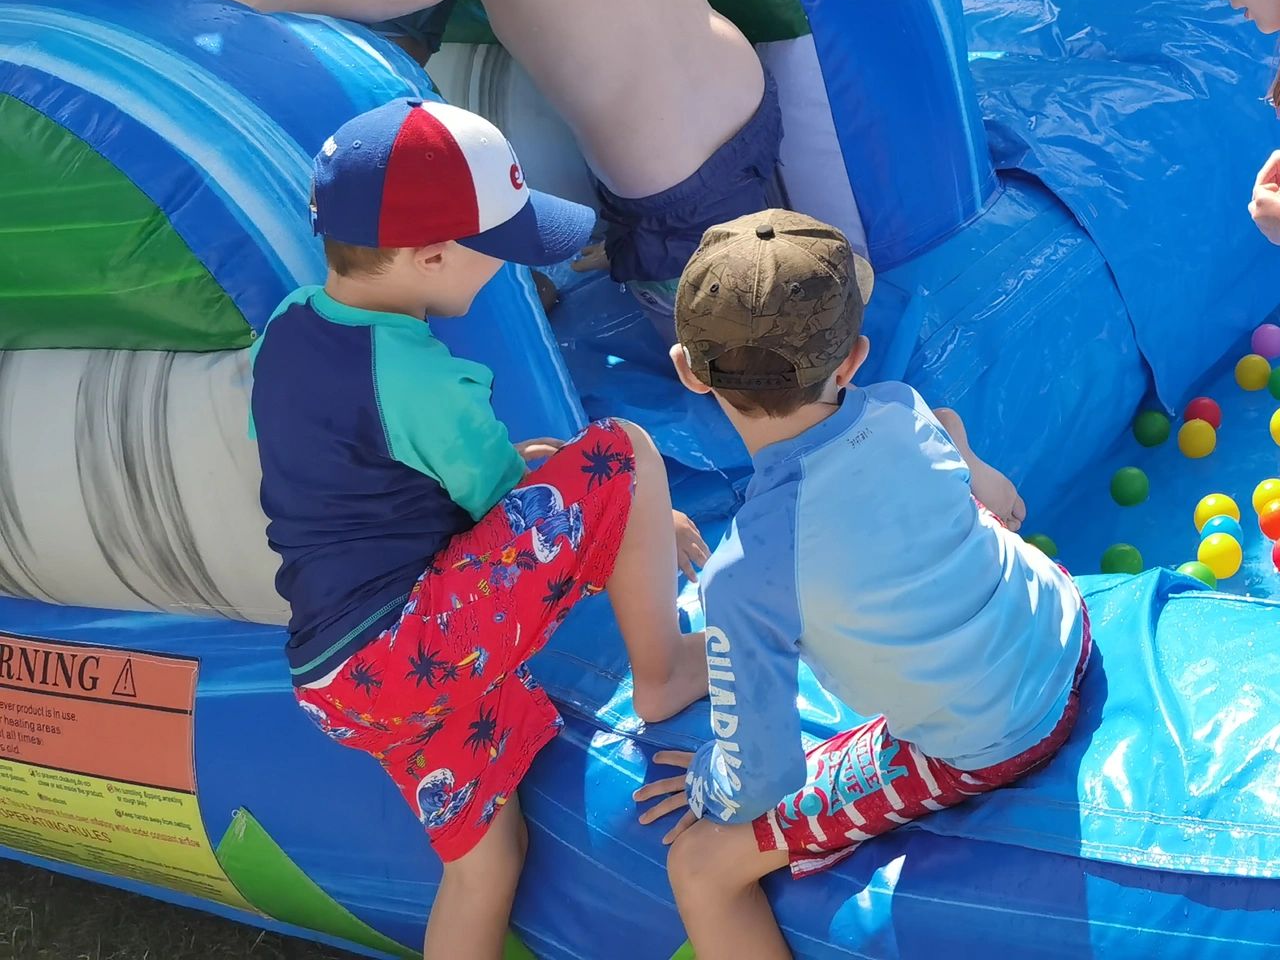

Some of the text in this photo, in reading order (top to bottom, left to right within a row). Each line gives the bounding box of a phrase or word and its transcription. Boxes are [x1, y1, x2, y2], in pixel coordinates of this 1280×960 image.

[0, 644, 100, 692] RNING
[17, 704, 43, 717] product
[46, 706, 52, 718] is
[53, 707, 60, 719] in
[62, 711, 78, 721] use.
[4, 715, 35, 732] heating
[6, 730, 16, 740] all
[0, 808, 68, 832] OPERATING
[68, 824, 112, 843] RULES
